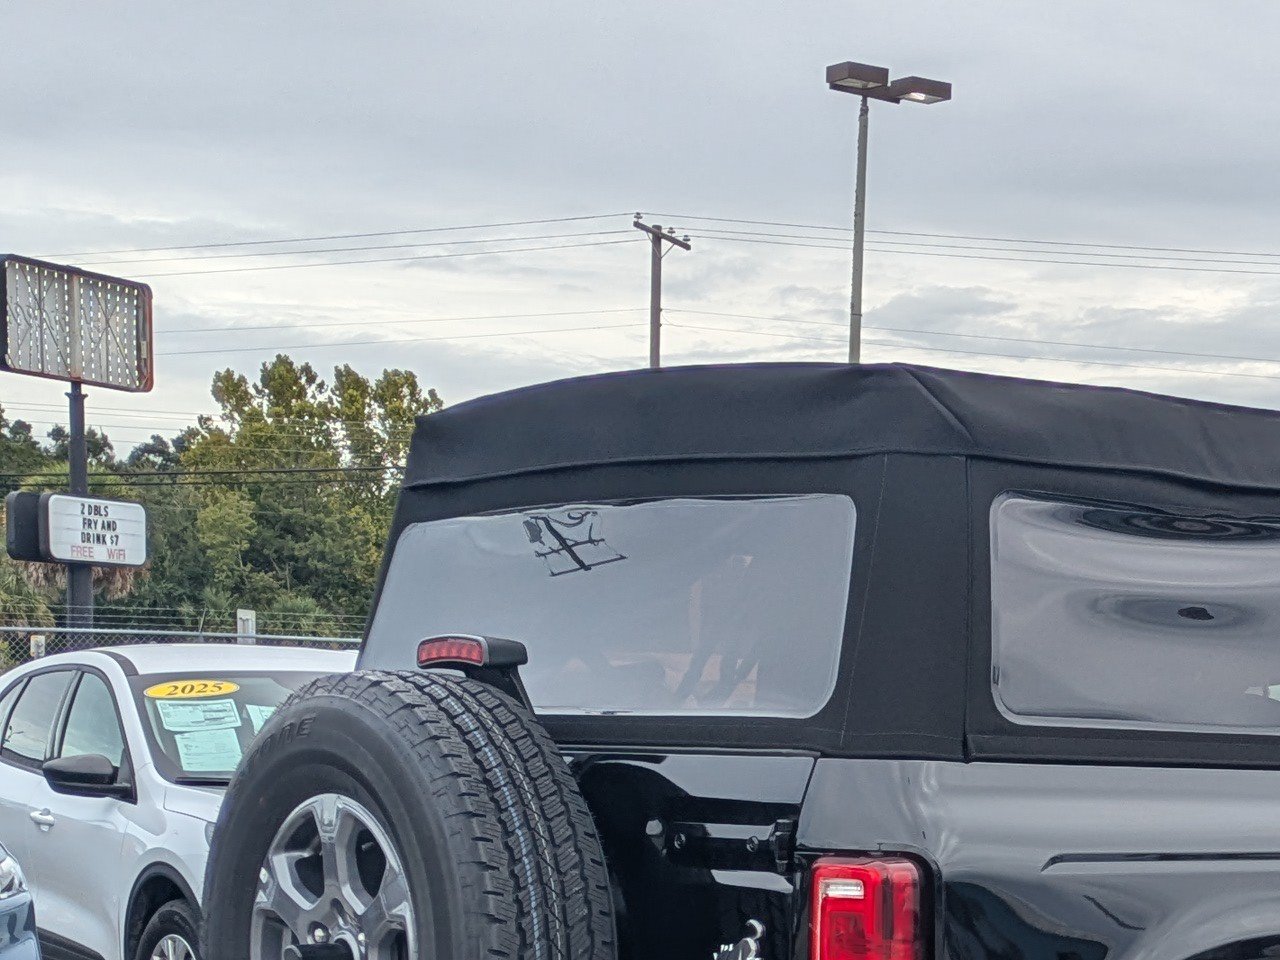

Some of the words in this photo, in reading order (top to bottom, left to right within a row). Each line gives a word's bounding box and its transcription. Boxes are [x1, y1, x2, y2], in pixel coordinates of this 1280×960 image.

[80, 502, 86, 515] 2
[87, 504, 109, 517] DBLS
[82, 517, 98, 530] FRY
[101, 519, 117, 532] AND
[80, 532, 107, 545] DRINK
[109, 534, 120, 546] $7
[71, 546, 94, 558] FREE
[165, 682, 224, 697] 2025
